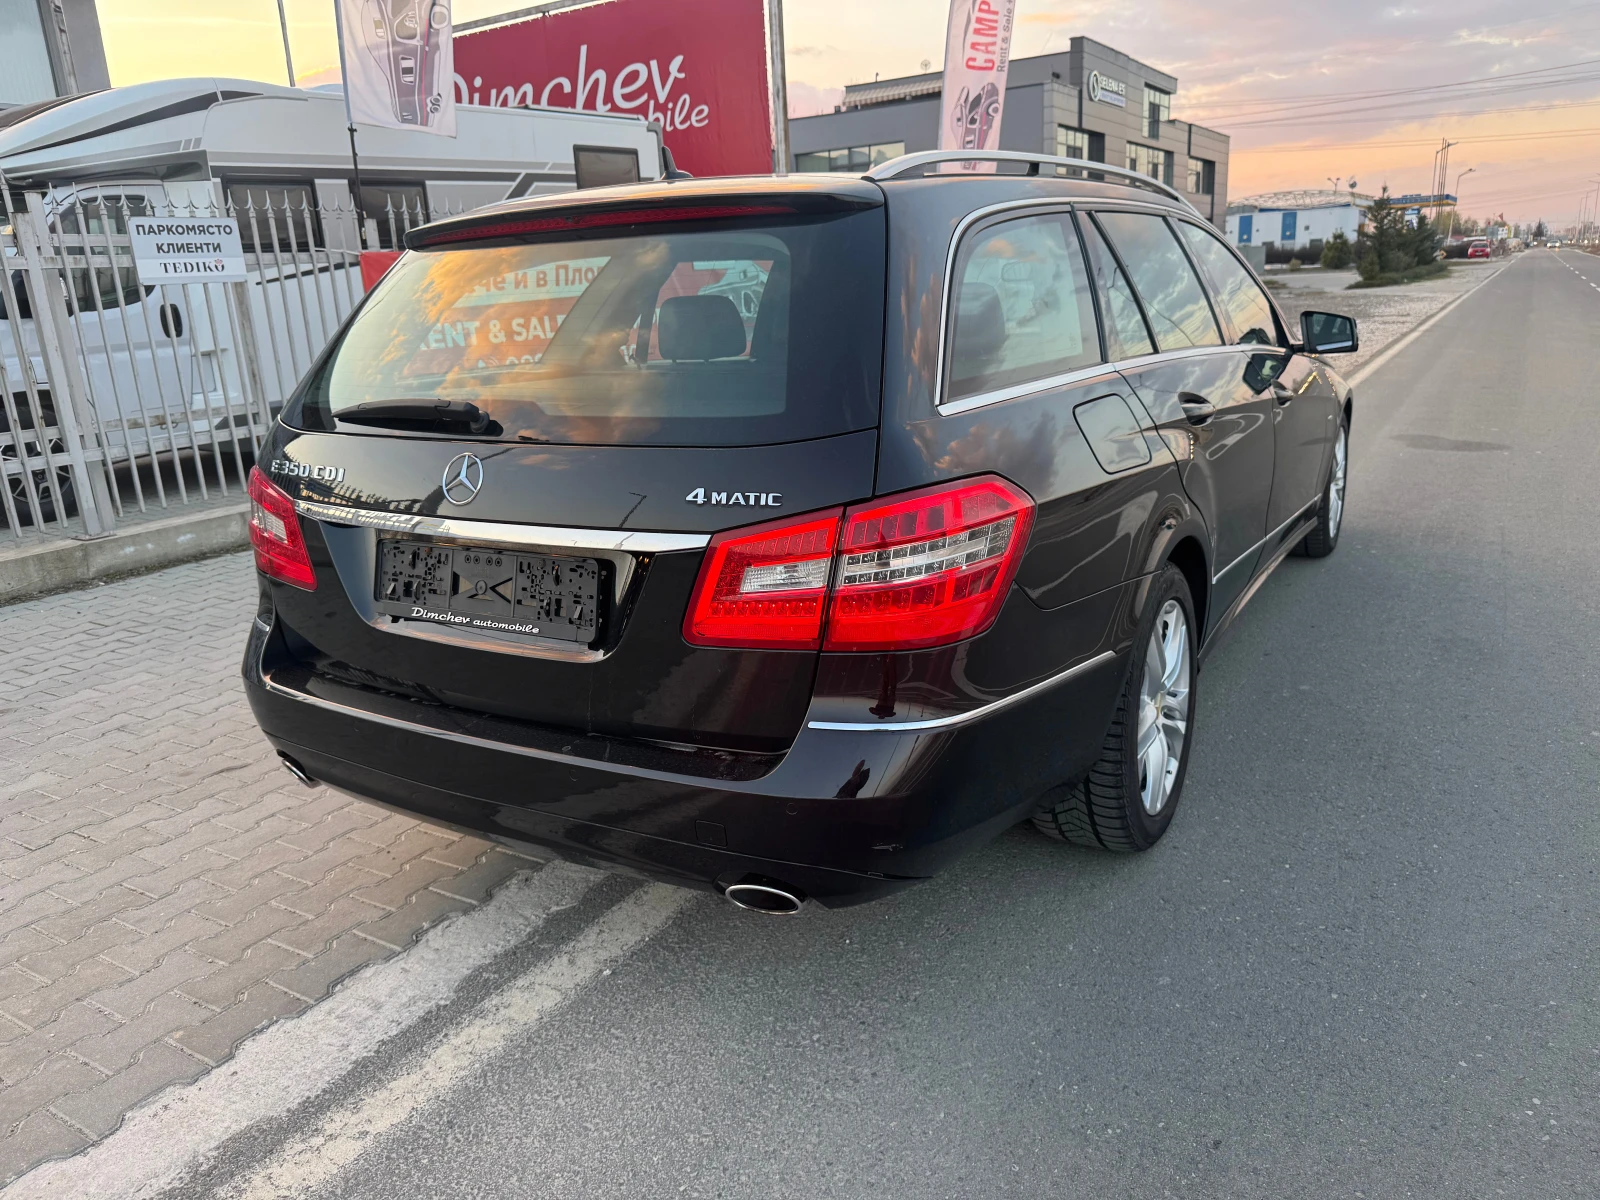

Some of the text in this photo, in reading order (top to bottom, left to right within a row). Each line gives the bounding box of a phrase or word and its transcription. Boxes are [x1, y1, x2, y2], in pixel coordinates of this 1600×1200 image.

[1002, 8, 1013, 33] Sale
[965, 0, 1000, 71] CAMP
[997, 47, 1009, 72] Rent
[135, 224, 233, 236] ПАРКОМЯСТО
[156, 242, 222, 254] КЛИЕНТИ
[160, 260, 225, 274] TEDIKO
[513, 271, 529, 290] и
[555, 263, 604, 287] Пло
[488, 319, 507, 344] &
[313, 465, 345, 482] CDI
[411, 606, 540, 634] Dimchev automobile
